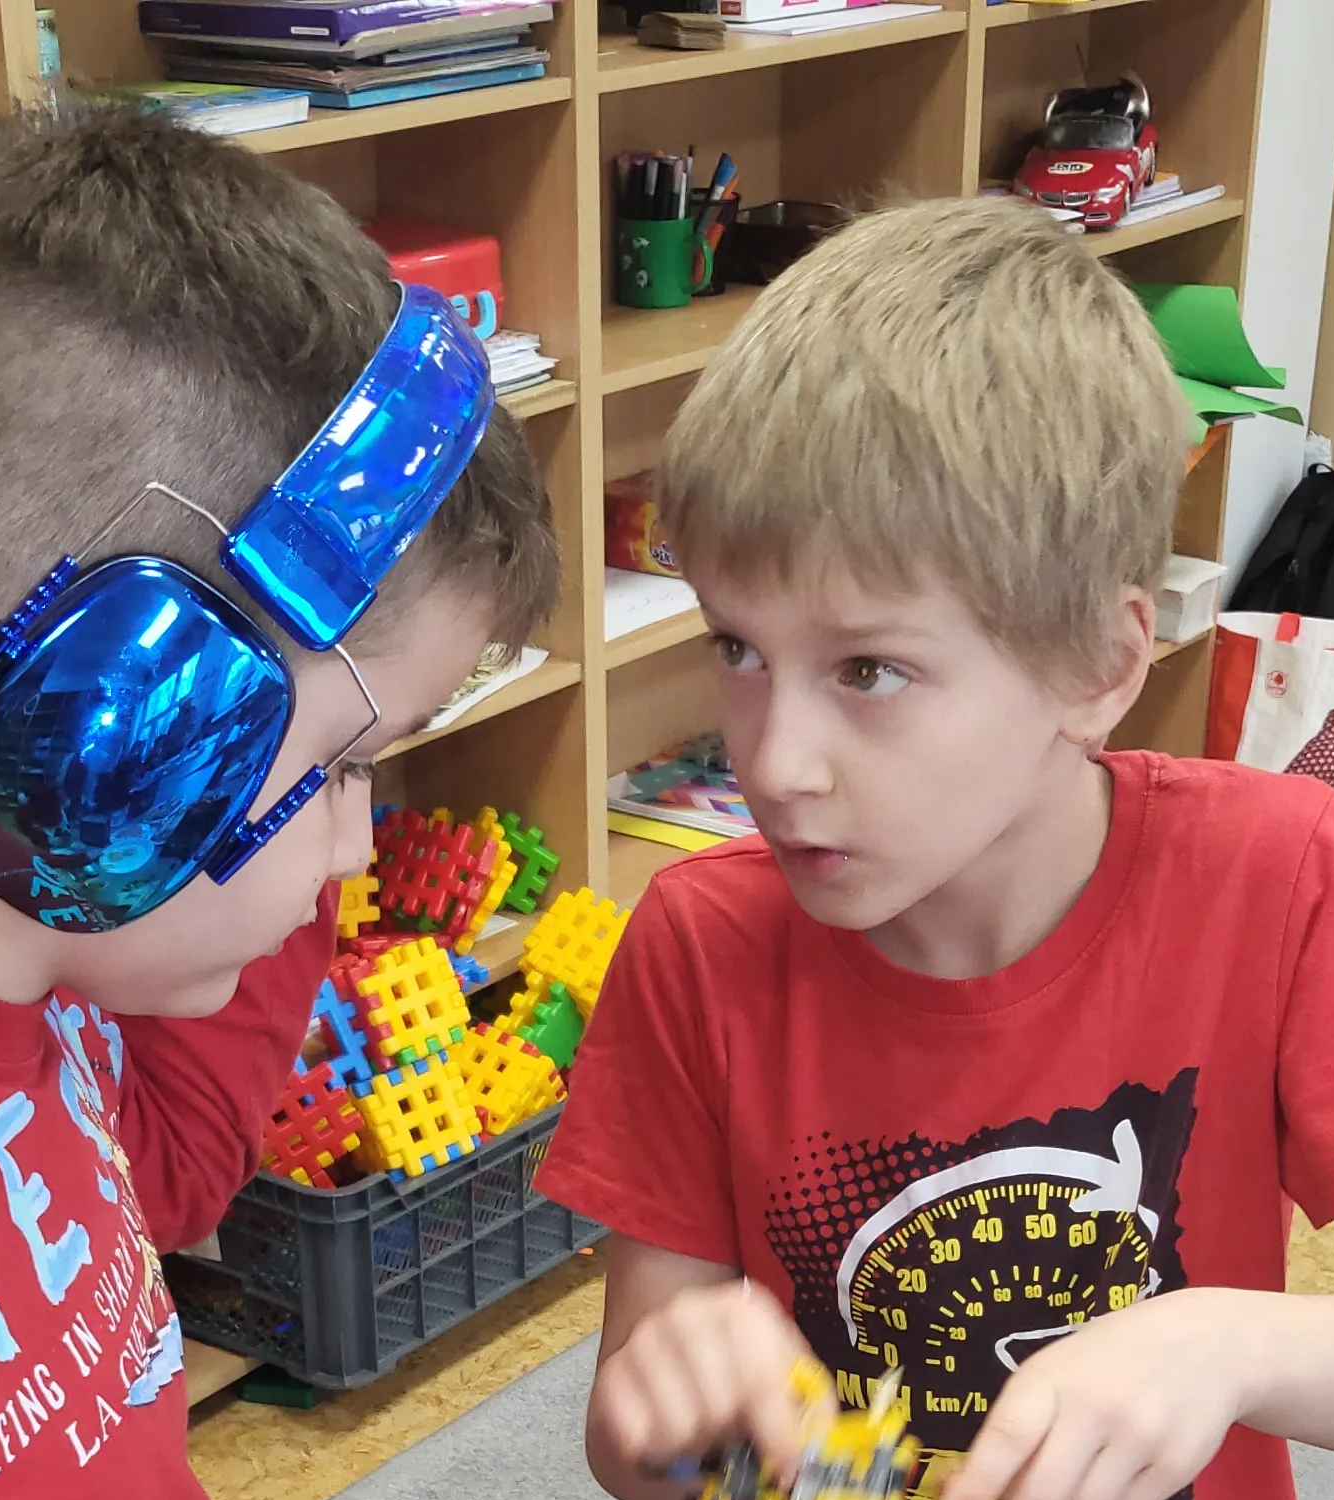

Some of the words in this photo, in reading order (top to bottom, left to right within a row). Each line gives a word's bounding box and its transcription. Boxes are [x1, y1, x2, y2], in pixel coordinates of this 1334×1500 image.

[971, 1217, 1003, 1243] 40
[1025, 1213, 1057, 1240] 50
[1068, 1220, 1097, 1248] 60
[930, 1238, 961, 1265] 30
[896, 1268, 927, 1293] 20
[1024, 1284, 1043, 1299] 80
[993, 1288, 1011, 1303] 60
[1047, 1291, 1072, 1307] 100
[1108, 1283, 1139, 1311] 80
[879, 1307, 908, 1331] 10
[965, 1301, 984, 1317] 40
[62, 1311, 103, 1378] IN
[948, 1325, 967, 1341] 20
[883, 1341, 899, 1367] 0
[944, 1355, 956, 1373] 0
[925, 1390, 988, 1417] km/h
[65, 1394, 122, 1468] LA
